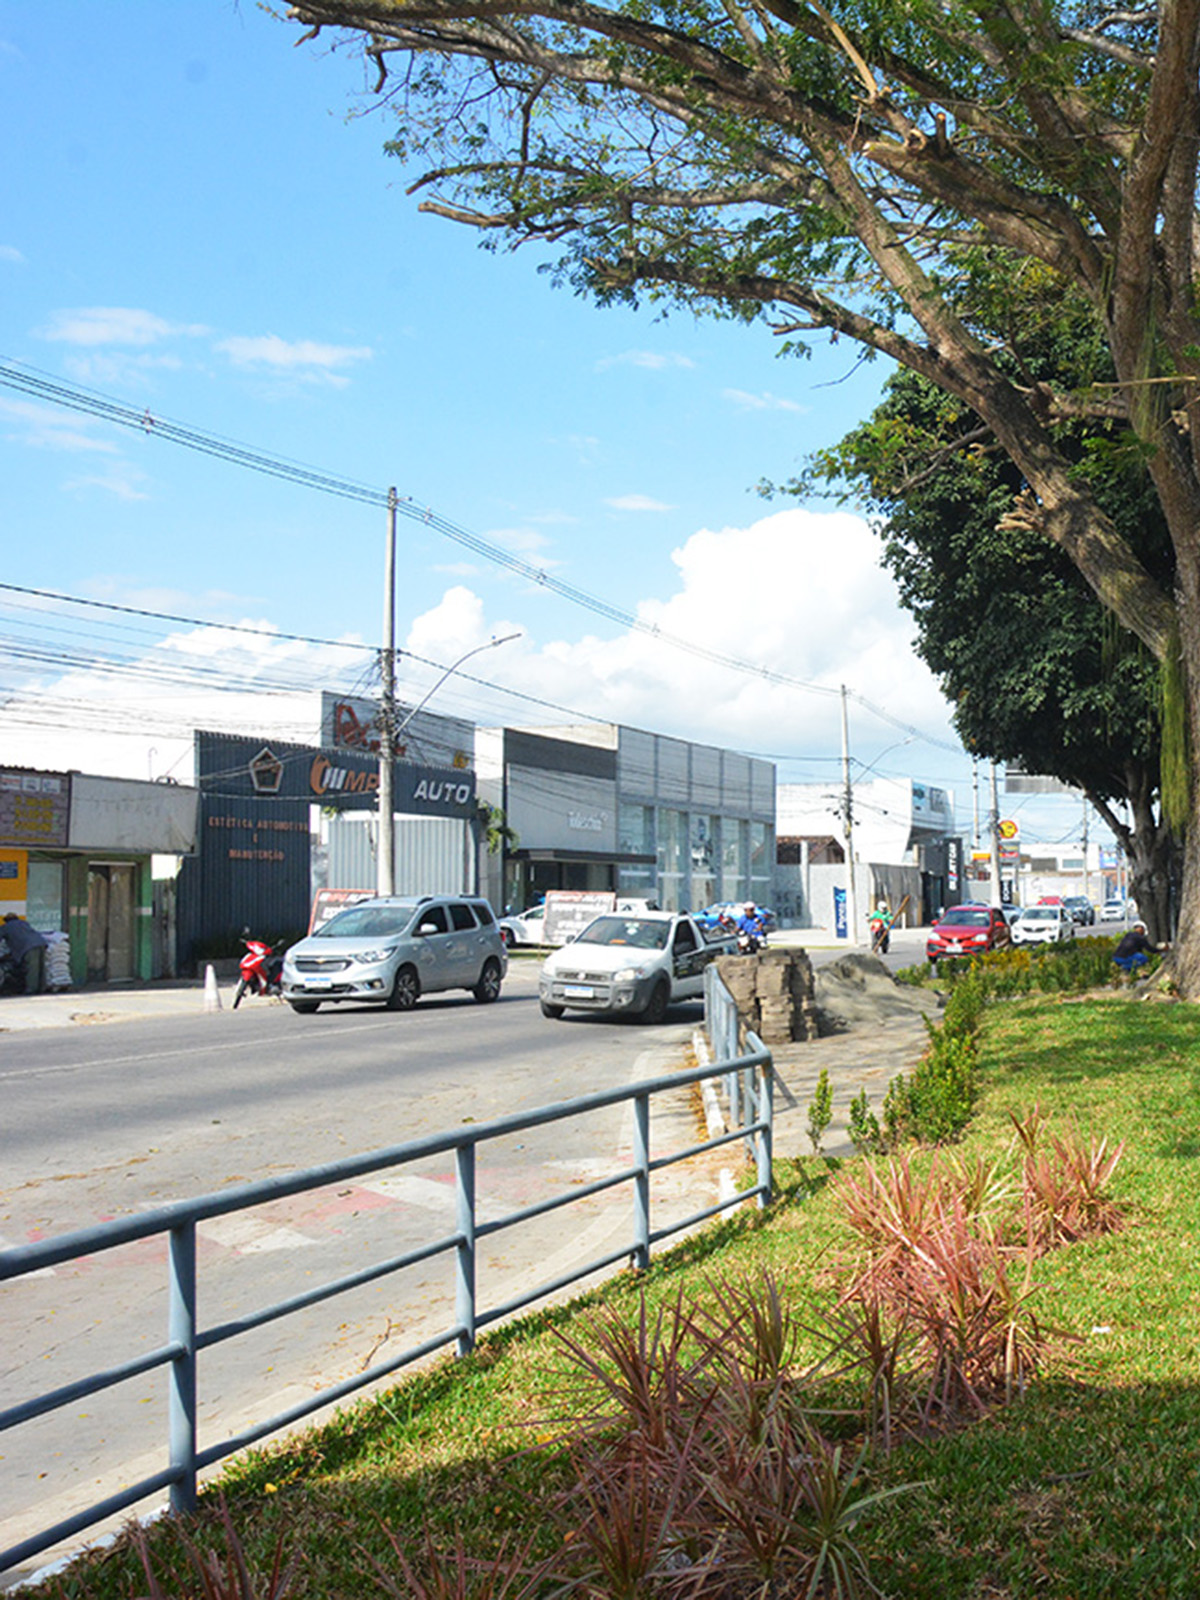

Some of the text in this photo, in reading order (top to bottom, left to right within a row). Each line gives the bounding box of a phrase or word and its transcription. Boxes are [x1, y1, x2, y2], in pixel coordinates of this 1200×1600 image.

[413, 779, 471, 804] AUTO
[208, 815, 253, 828] ESTÉTICA
[253, 833, 258, 843] E
[229, 848, 285, 860] MANUTENÇÃO
